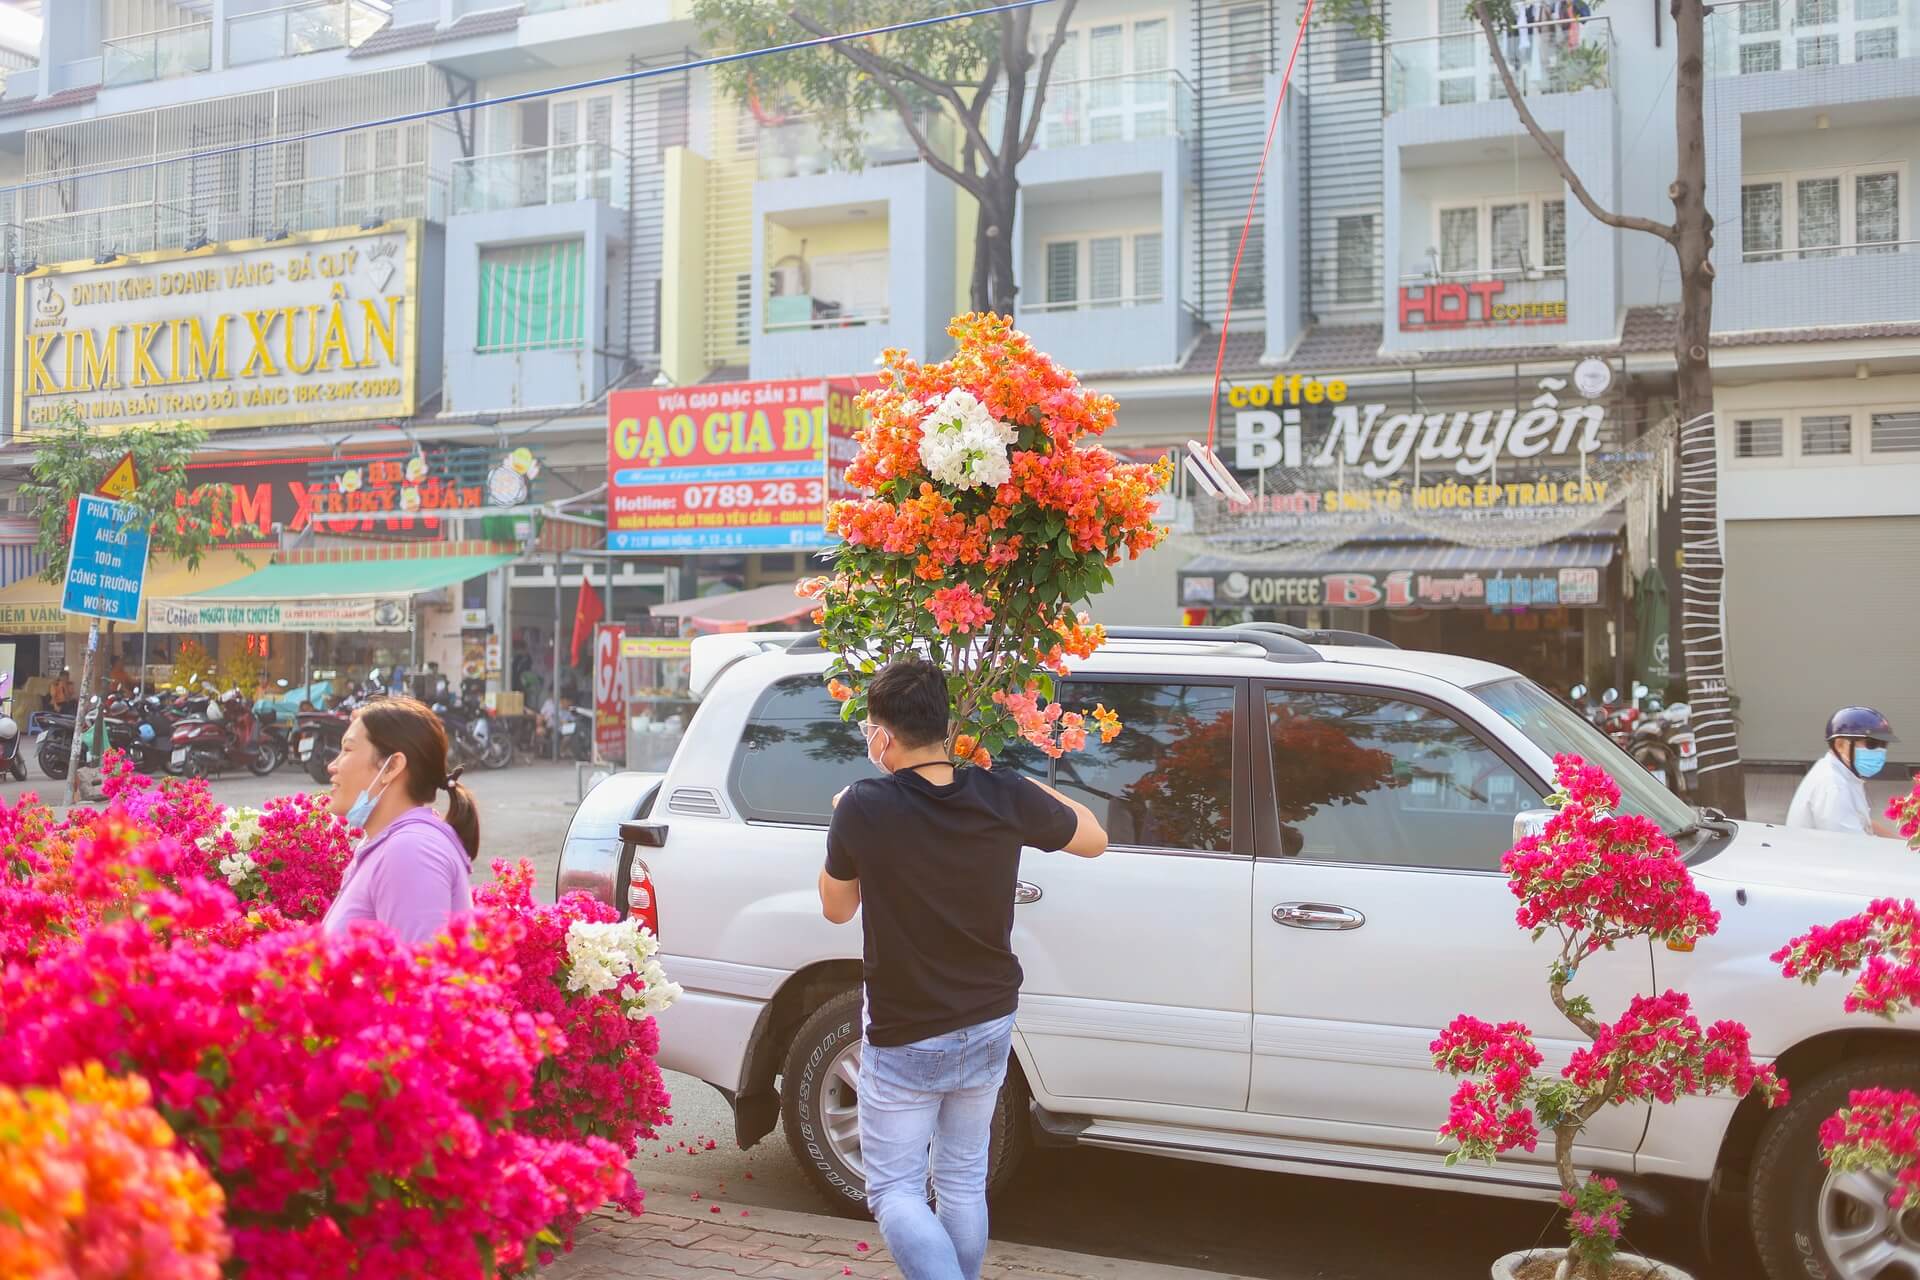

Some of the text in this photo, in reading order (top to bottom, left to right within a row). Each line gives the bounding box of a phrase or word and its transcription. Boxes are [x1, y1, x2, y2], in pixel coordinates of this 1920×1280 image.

[72, 281, 114, 306] DNTN
[118, 276, 156, 301] KINH
[160, 267, 219, 296] DOANH
[225, 258, 273, 289] VÀNG
[288, 251, 314, 282] ĐÁ
[1398, 280, 1567, 323] HOT COFFEE
[24, 283, 404, 396] KIM KIM XUÂN
[29, 398, 87, 425] CHUYN
[92, 400, 125, 419] MUA
[127, 392, 159, 416] BÁN
[163, 390, 206, 413] TRAO
[243, 384, 289, 408] VÀNG
[787, 387, 798, 402] 3
[1228, 374, 1349, 408] coffee
[614, 414, 697, 467] GẠO
[702, 409, 776, 456] GIA
[1235, 377, 1605, 478] Bi Nguyễn
[614, 495, 677, 511] Hotline:
[683, 481, 823, 509] 0789.26.3
[1504, 475, 1558, 506] TRÁI
[1563, 476, 1609, 506] CÂY
[86, 502, 109, 520] PHÍA
[95, 528, 128, 546] AHEAD
[70, 570, 138, 594] CÔNG TRƯỜNG
[1250, 577, 1319, 604] COFFEE
[83, 594, 119, 613] WORKS
[167, 606, 198, 627] Coffee
[799, 1022, 866, 1202] BRIDGESTONE
